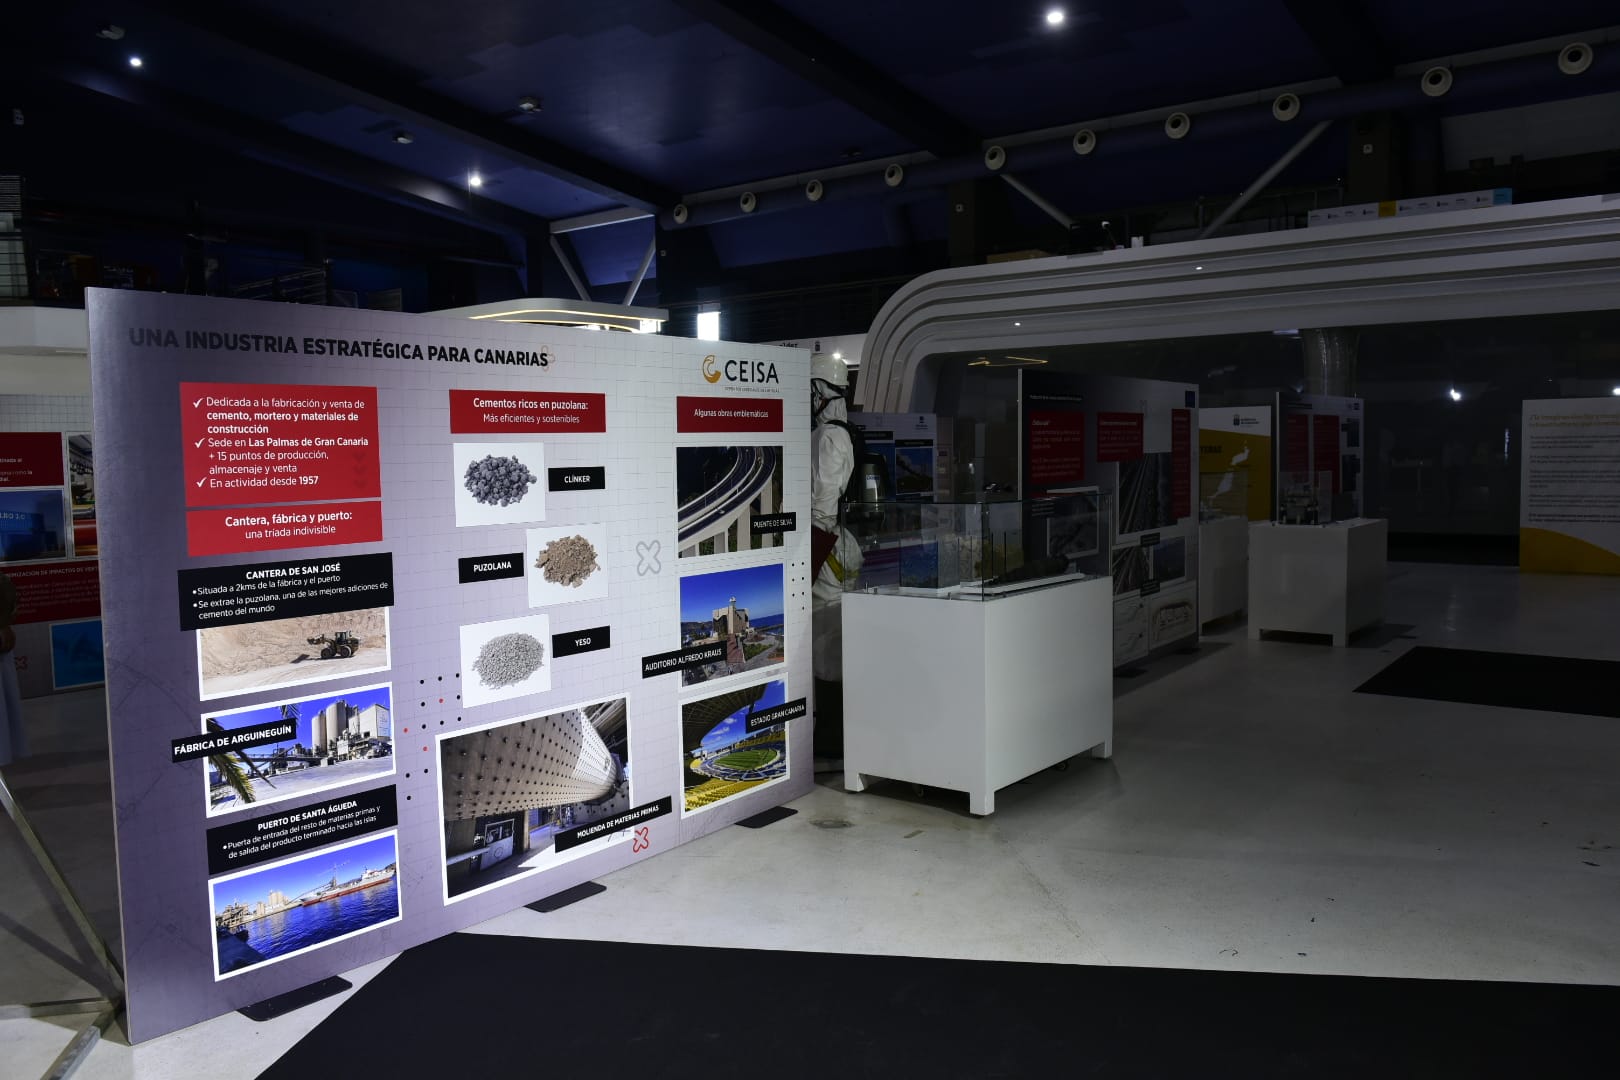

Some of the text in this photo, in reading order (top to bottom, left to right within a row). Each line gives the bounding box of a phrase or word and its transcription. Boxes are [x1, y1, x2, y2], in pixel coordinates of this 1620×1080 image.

[130, 328, 548, 367] UNA INDUSTRIA ESTRATÉGICA PARA CANARIAS
[724, 360, 779, 384] CEISA
[206, 397, 364, 410] Dedicada a la fabricación y venta de
[474, 398, 516, 409] Cementos
[518, 399, 538, 409] ricos
[552, 400, 588, 411] puzolana:
[207, 412, 358, 422] cemento, mortero y materiales de
[484, 414, 580, 424] Más eficientes y sostenibles
[694, 409, 716, 417] Algunas
[718, 409, 732, 417] obras
[208, 424, 268, 434] construcción
[208, 438, 232, 447] Sede
[248, 438, 264, 447] Las
[267, 438, 298, 446] Palmas
[302, 438, 312, 446] de
[315, 438, 334, 446] Gran
[337, 437, 368, 446] Canaria
[217, 452, 226, 460] 15
[230, 451, 262, 462] puntos
[264, 451, 276, 460] de
[278, 450, 328, 461] producción,
[210, 464, 297, 475] almacenaje y venta
[210, 476, 319, 488] En actividad desde 1957
[225, 512, 352, 527] Cantera, fábrica y puerto:
[754, 520, 772, 528] PUENTE
[293, 525, 336, 536] indivisible
[246, 563, 340, 580] CANTERA DE SAN JOSÉ
[474, 562, 512, 572] PUZOLANA
[198, 586, 227, 596] Situada
[236, 582, 256, 591] 2kms
[258, 581, 267, 589] de
[269, 580, 276, 588] la
[277, 578, 301, 588] fábrica
[318, 575, 340, 586] puerto
[198, 600, 208, 609] Se
[210, 598, 234, 607] extrae
[236, 596, 243, 604] la
[245, 594, 280, 605] puzolana,
[319, 586, 346, 596] mejores
[347, 584, 378, 594] adiciones
[198, 605, 275, 620] cemento del mundo
[575, 638, 591, 646] YESO
[644, 648, 721, 671] AUDITORIO ALFREDO KRAUS
[751, 704, 804, 726] ESTADIO GRAN CANARIA
[174, 725, 292, 755] FÁBRICA DE ARGUINEGUÍN
[258, 817, 288, 831] PUERTO
[302, 808, 326, 820] SANTA
[328, 800, 357, 813] ÁGUEDA
[577, 824, 605, 839] MOLIENDA
[614, 812, 640, 826] MATERIAS
[640, 805, 659, 817] PRIMAS
[228, 839, 251, 849] Puerta
[252, 836, 261, 844] de
[262, 829, 288, 841] entrada
[290, 826, 300, 835] del
[301, 822, 317, 832] resto
[328, 813, 354, 824] materias
[355, 807, 375, 819] primas
[228, 851, 238, 859] de
[239, 846, 259, 856] salida
[261, 842, 271, 851] del
[272, 835, 302, 848] producto
[304, 827, 336, 839] terminado
[337, 822, 353, 831] hacia
[364, 815, 376, 825] islas
